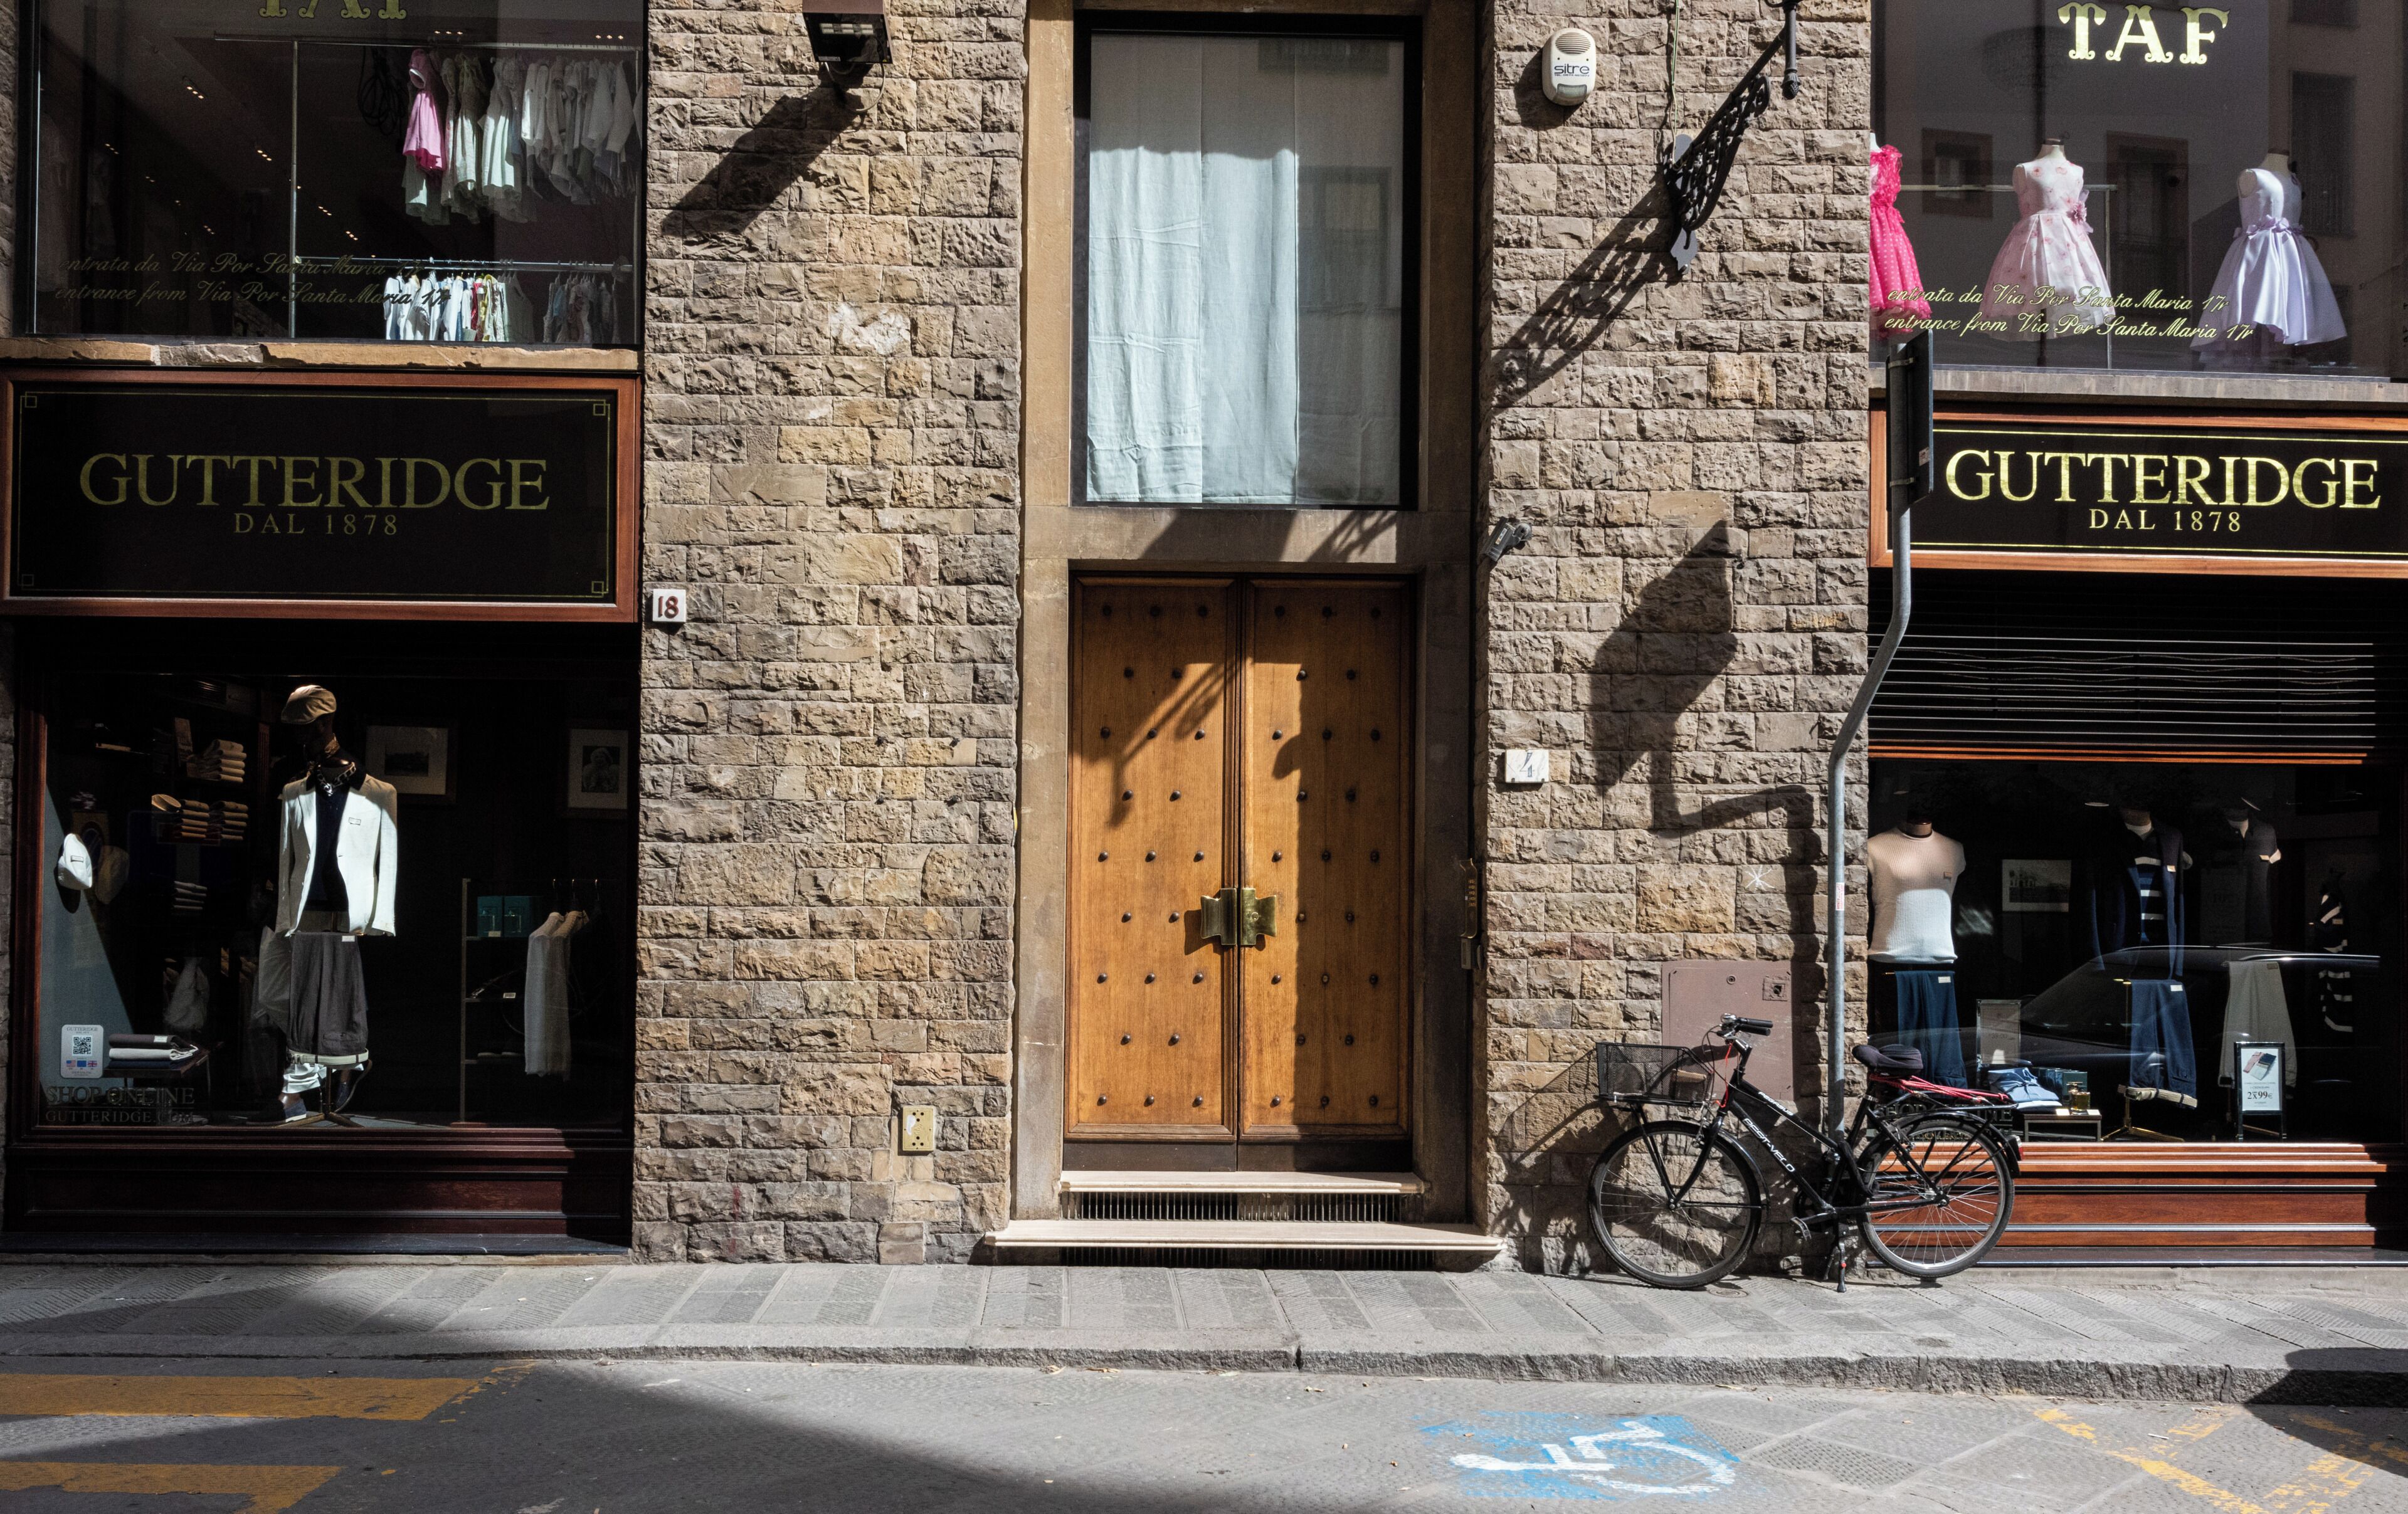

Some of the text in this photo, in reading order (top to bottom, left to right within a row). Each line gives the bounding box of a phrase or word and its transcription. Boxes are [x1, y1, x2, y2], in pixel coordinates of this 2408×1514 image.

[2057, 2, 2231, 65] TAF
[1555, 63, 1590, 74] sitre
[60, 254, 130, 271] entrata
[135, 253, 161, 271] da
[171, 251, 206, 271] Via
[211, 252, 255, 273] Por
[256, 253, 321, 275] Santa
[324, 255, 387, 275] Maria
[55, 284, 137, 299] entrance
[135, 280, 187, 307] from
[197, 280, 233, 302] Via
[236, 281, 280, 302] Por
[282, 282, 348, 303] Santa
[349, 283, 413, 304] Maria
[1888, 284, 2229, 313] entrata da Via Por Santa Maria 17r
[1884, 312, 2254, 341] entrance from Via Por Santa Maria 17r
[79, 453, 549, 511] GUTTERIDGE
[1945, 449, 2381, 509] GUTTERIDGE
[234, 513, 399, 536] DAL 1878
[2089, 508, 2241, 532] DAL 1878
[658, 596, 679, 619] 18
[1519, 752, 1535, 777] 4
[47, 1086, 196, 1104] SHOP ONLINE
[1743, 1118, 1795, 1172] BEST-VELO
